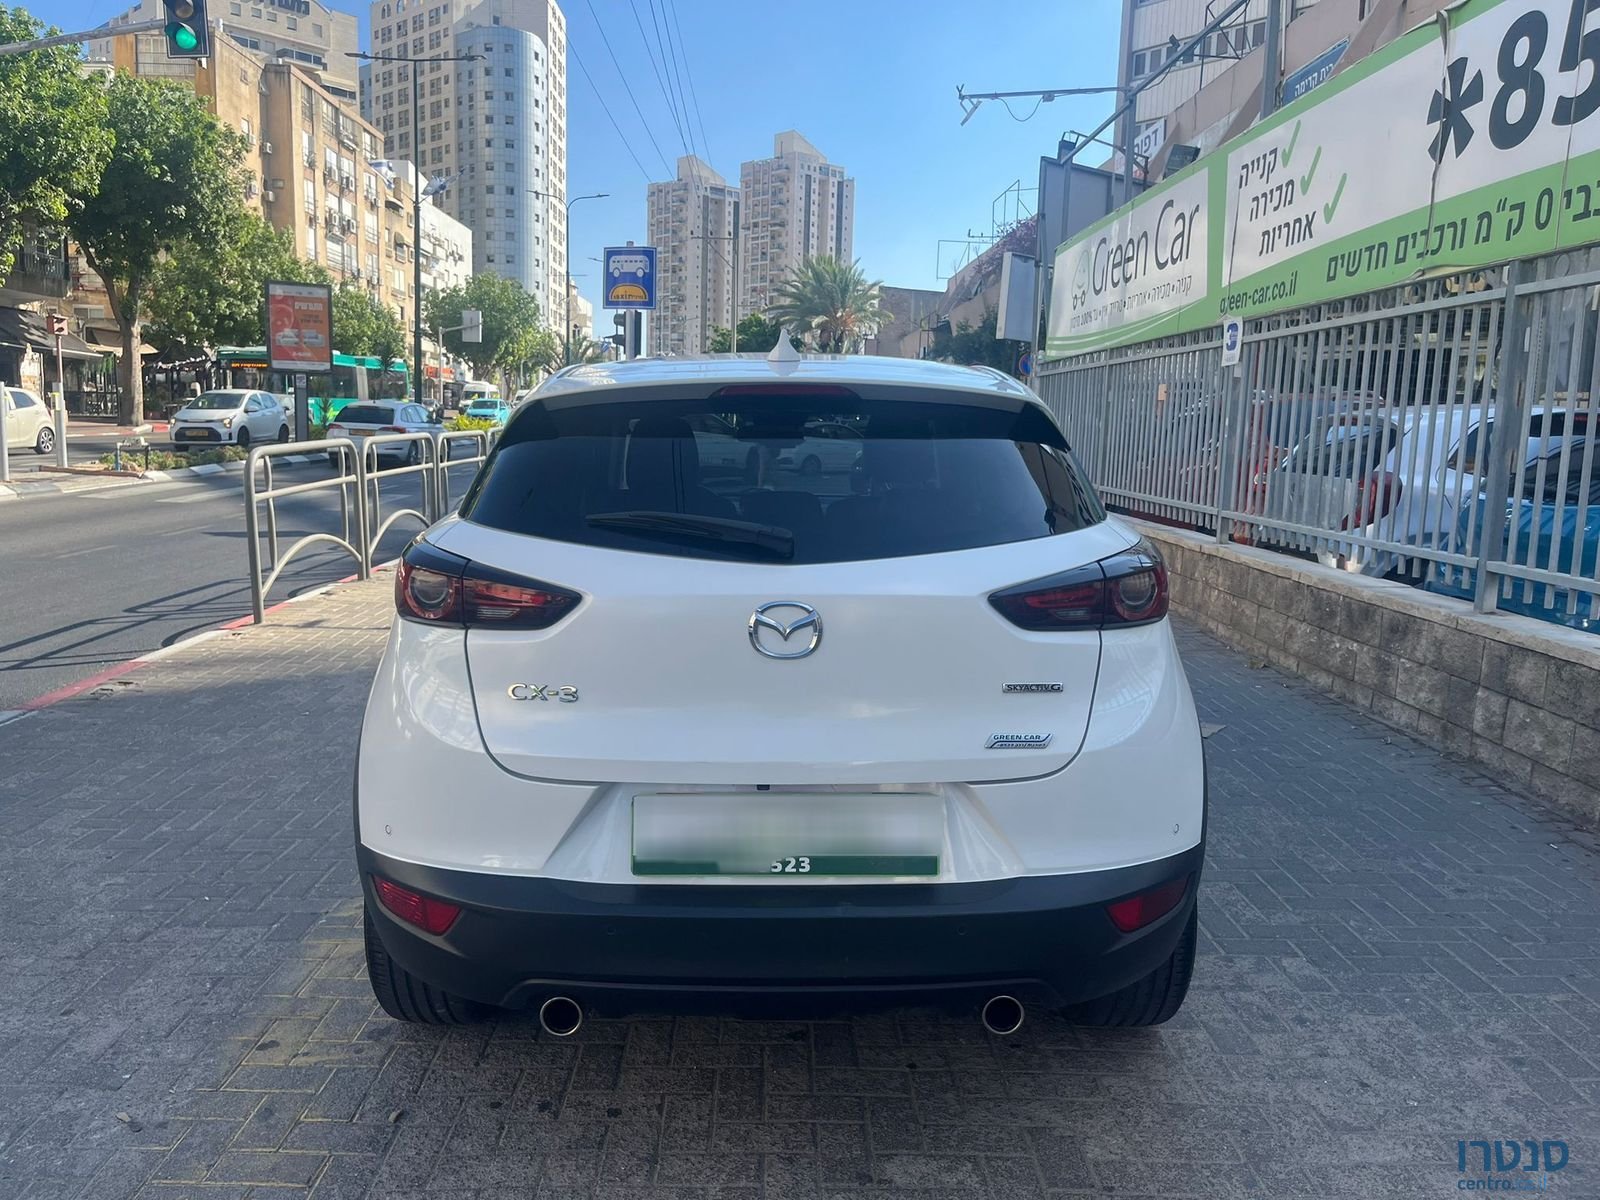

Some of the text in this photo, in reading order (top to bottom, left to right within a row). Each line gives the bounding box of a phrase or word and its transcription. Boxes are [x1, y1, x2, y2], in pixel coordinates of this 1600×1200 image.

[1238, 147, 1279, 189] קנייה
[1249, 178, 1296, 222] מכירה
[1534, 187, 1555, 231] 0
[1092, 199, 1200, 296] Green Car
[1258, 210, 1318, 257] אחריות
[1394, 216, 1468, 265] ורכבים
[1326, 241, 1389, 283] חדשים
[1219, 270, 1298, 314] geen-car.co.il
[507, 682, 579, 703] CX-3
